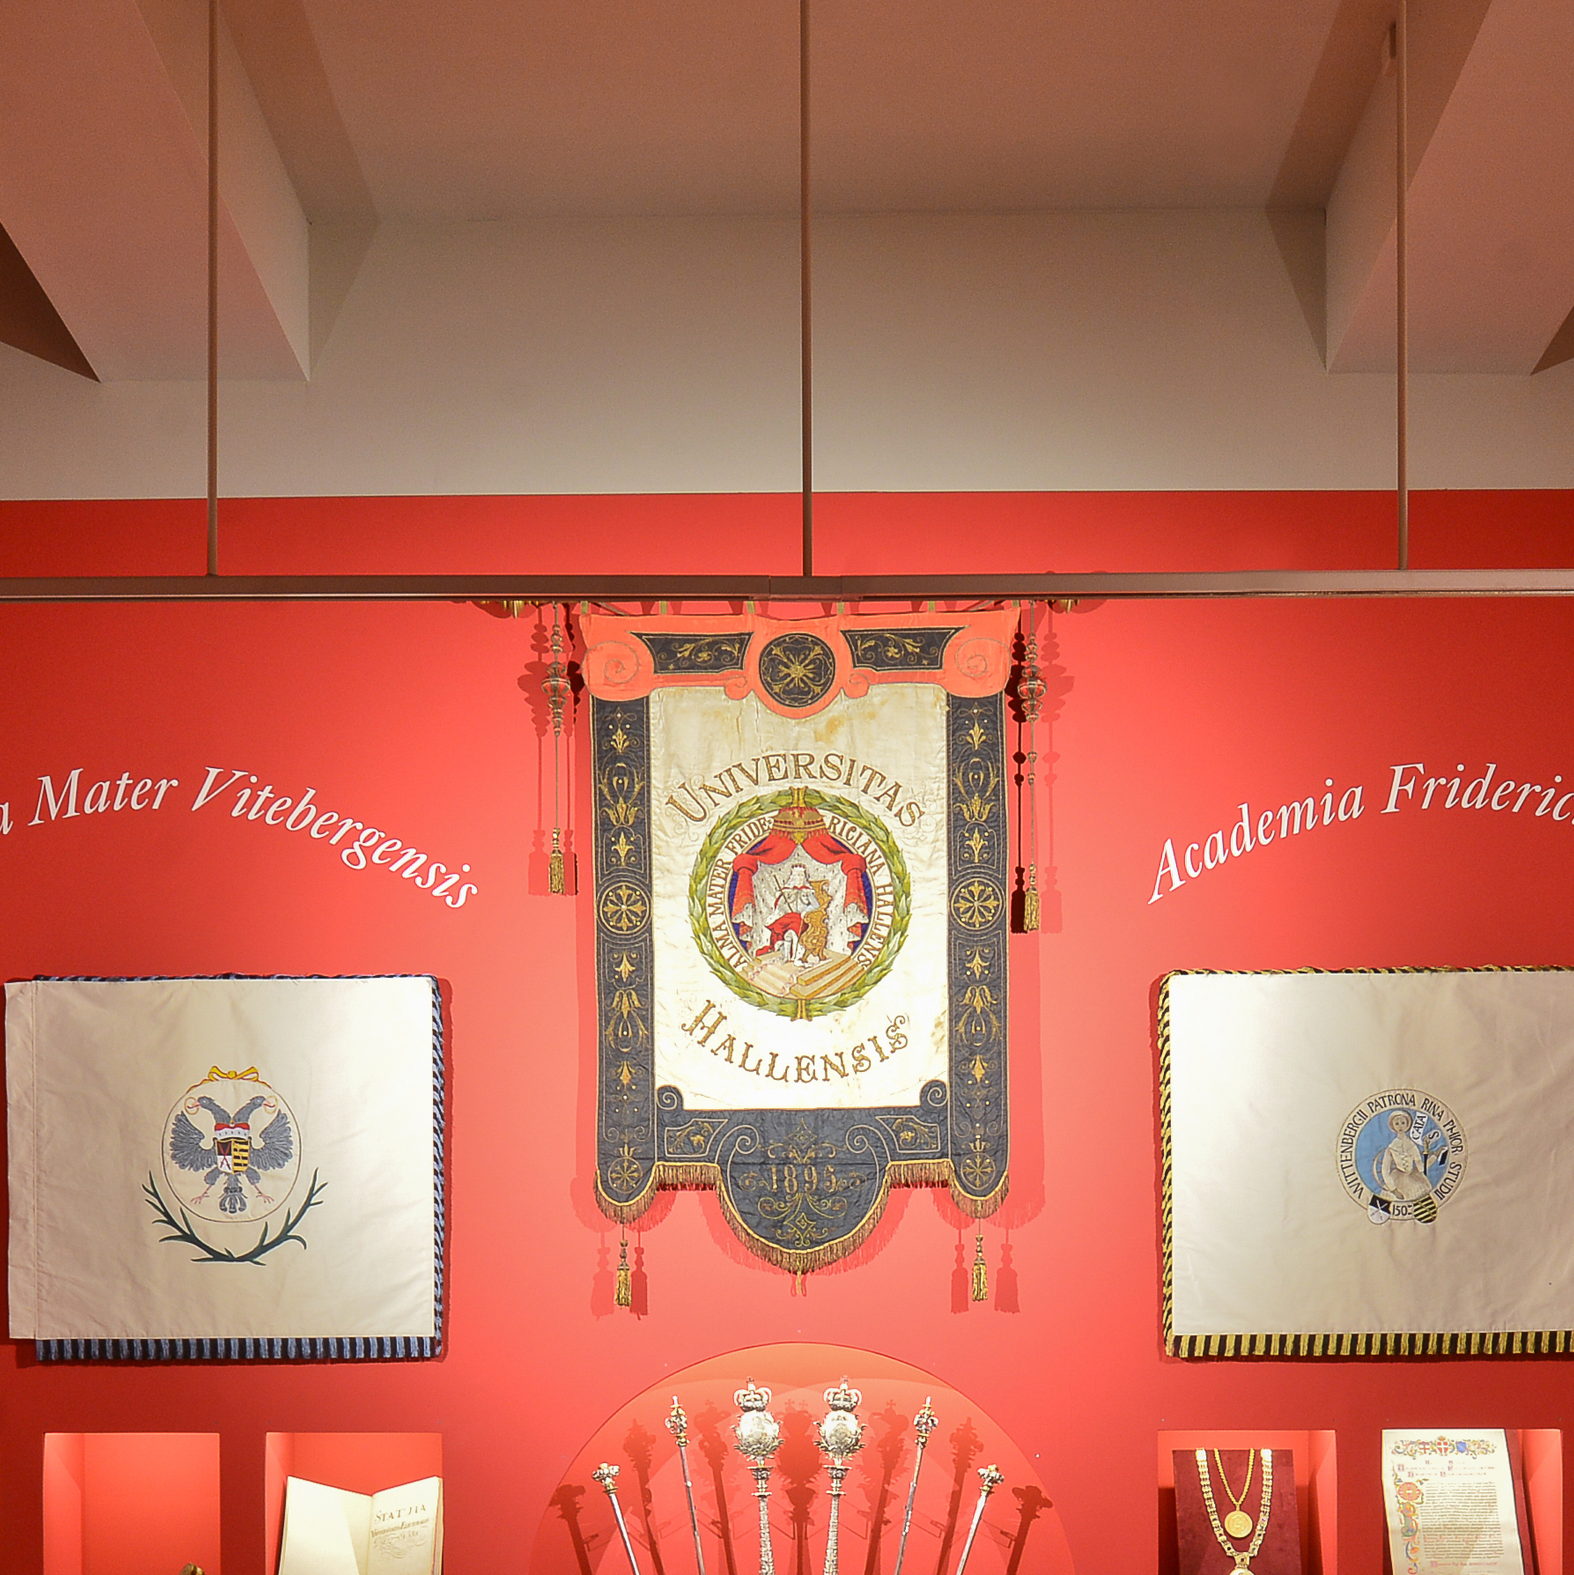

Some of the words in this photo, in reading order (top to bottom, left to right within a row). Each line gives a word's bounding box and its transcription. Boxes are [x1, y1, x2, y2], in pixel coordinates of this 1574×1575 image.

[664, 752, 926, 827] UNIVERSITAS
[28, 768, 179, 826] Mater
[190, 766, 478, 909] Vitebergensis
[829, 815, 885, 874] RICIANA
[1147, 777, 1365, 904] Academia
[708, 859, 732, 918] MATER
[713, 920, 747, 971] ALMA
[681, 999, 909, 1083] HALLENSIS
[1340, 1109, 1368, 1199] WITTENBERGII
[1367, 1093, 1416, 1113] PATRONA
[1413, 1115, 1426, 1140] CATA
[770, 1165, 838, 1194] 1895
